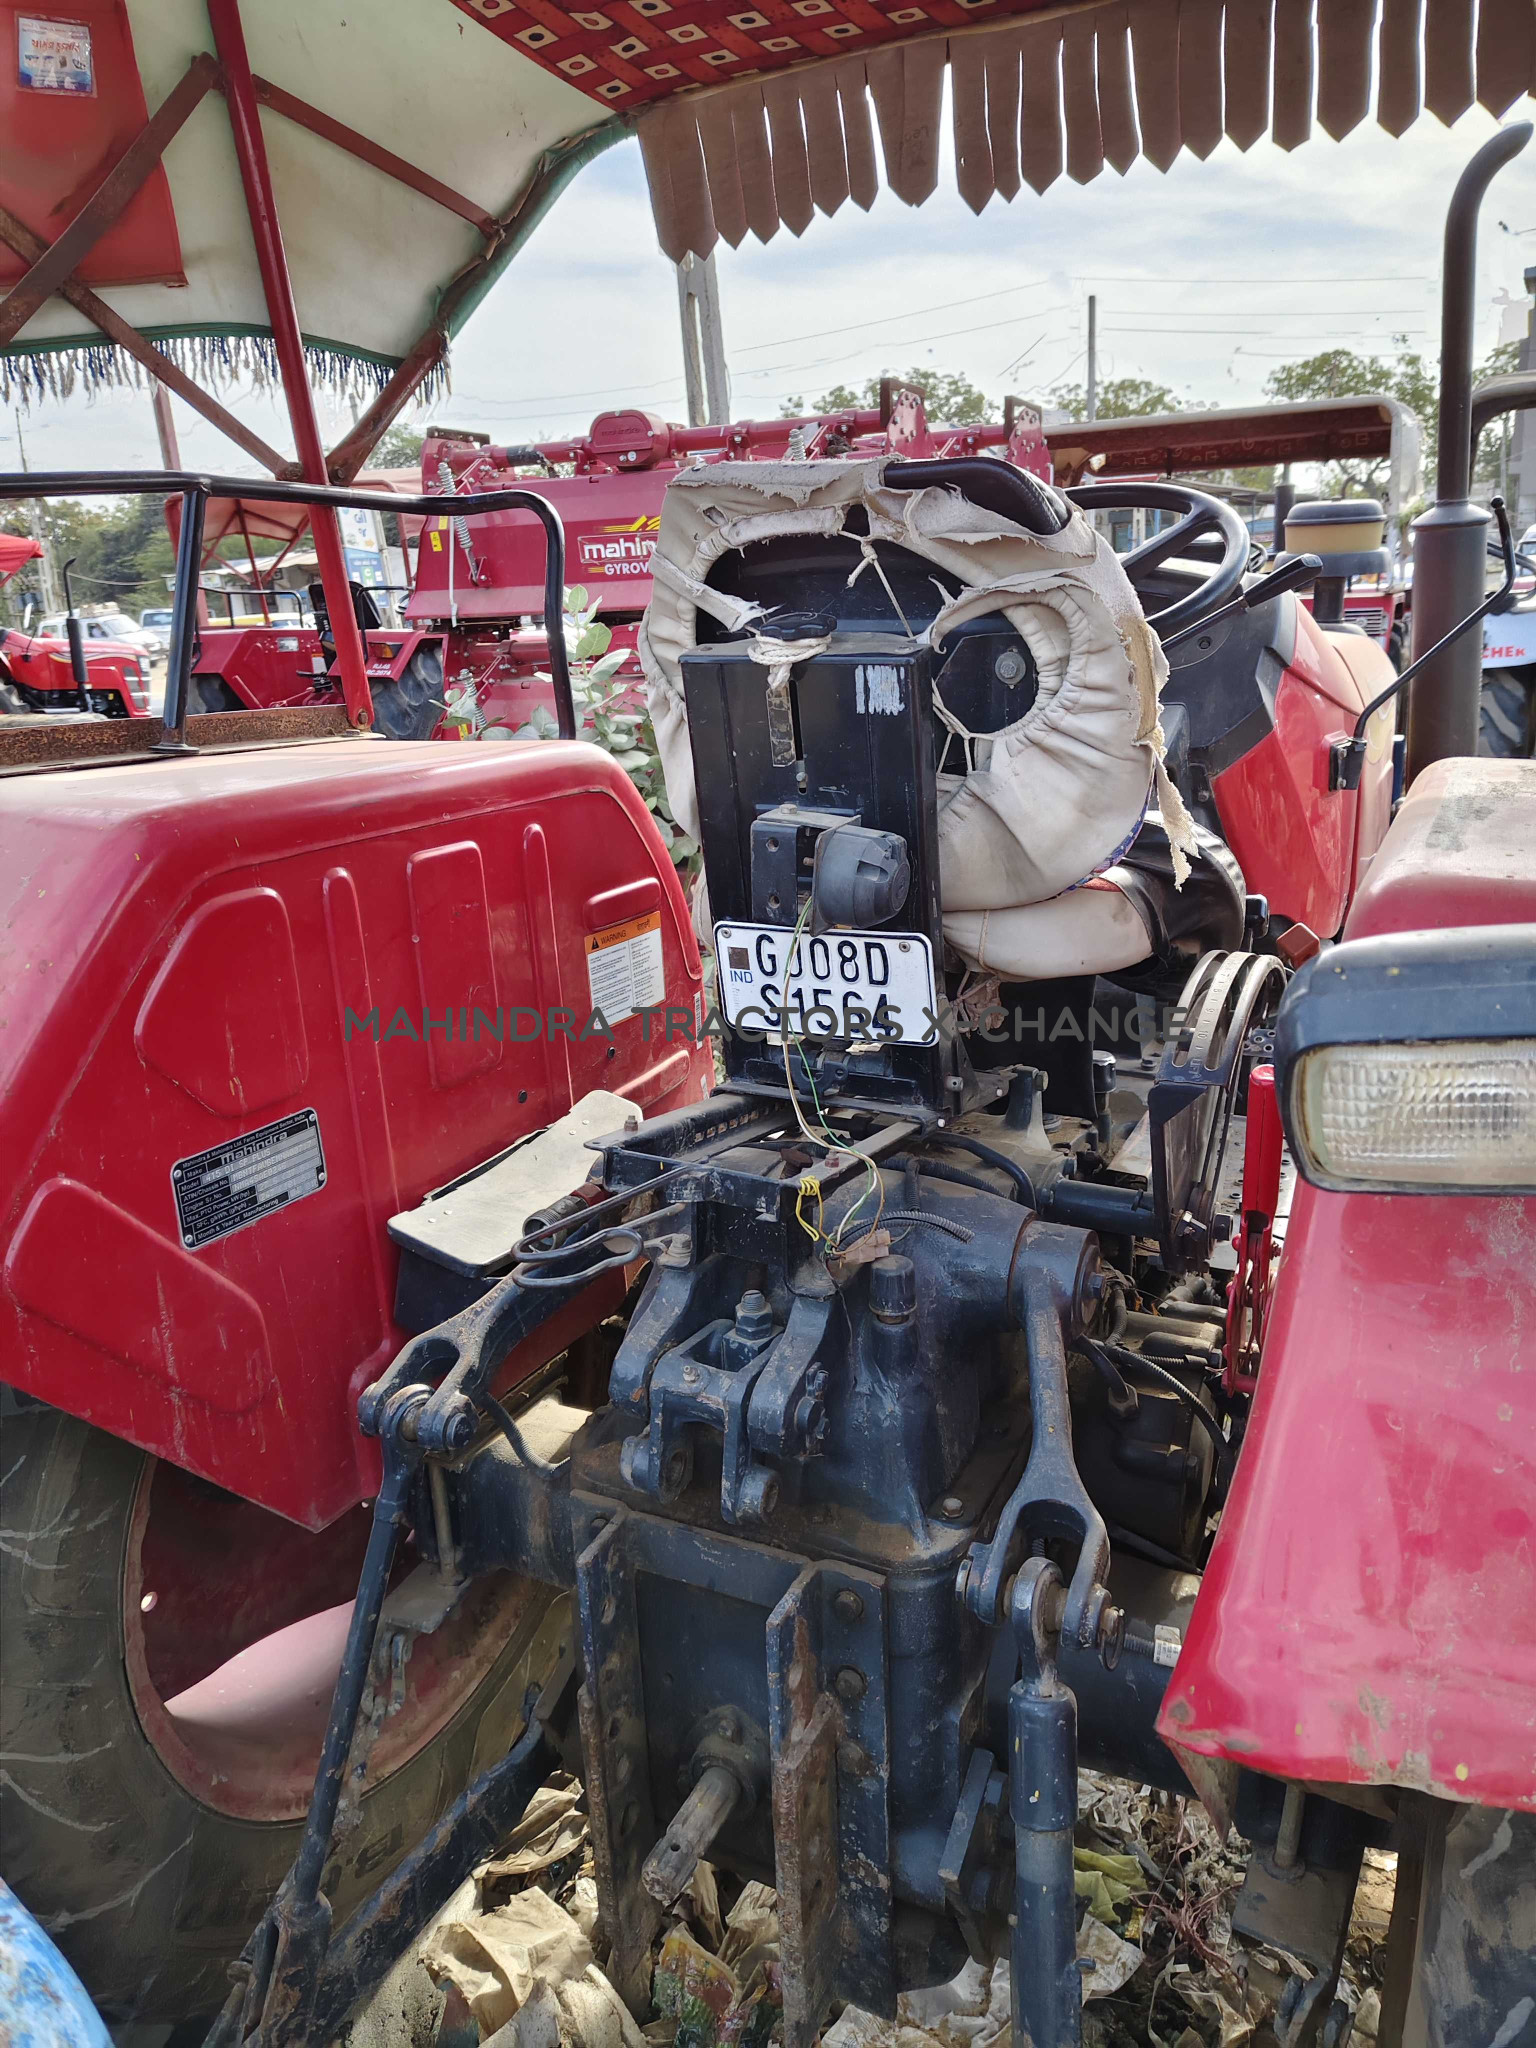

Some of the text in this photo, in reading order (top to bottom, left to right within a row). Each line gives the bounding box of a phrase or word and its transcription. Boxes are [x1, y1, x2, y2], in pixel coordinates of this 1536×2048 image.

[604, 561, 650, 576] GYROV
[600, 929, 627, 945] WARNING
[755, 933, 890, 986] GJ08D
[729, 969, 754, 984] IND
[183, 1156, 207, 1168] Mahindra
[211, 1144, 233, 1157] Mahindra
[221, 1132, 288, 1165] mahindra
[181, 1181, 199, 1192] Model
[224, 1164, 234, 1174] DI
[252, 1148, 271, 1162] PLUS
[187, 1168, 202, 1178] Make
[185, 1201, 203, 1213] Engine
[198, 1228, 215, 1240] Month
[221, 1219, 234, 1229] Year
[243, 1199, 278, 1219] Manufacturing
